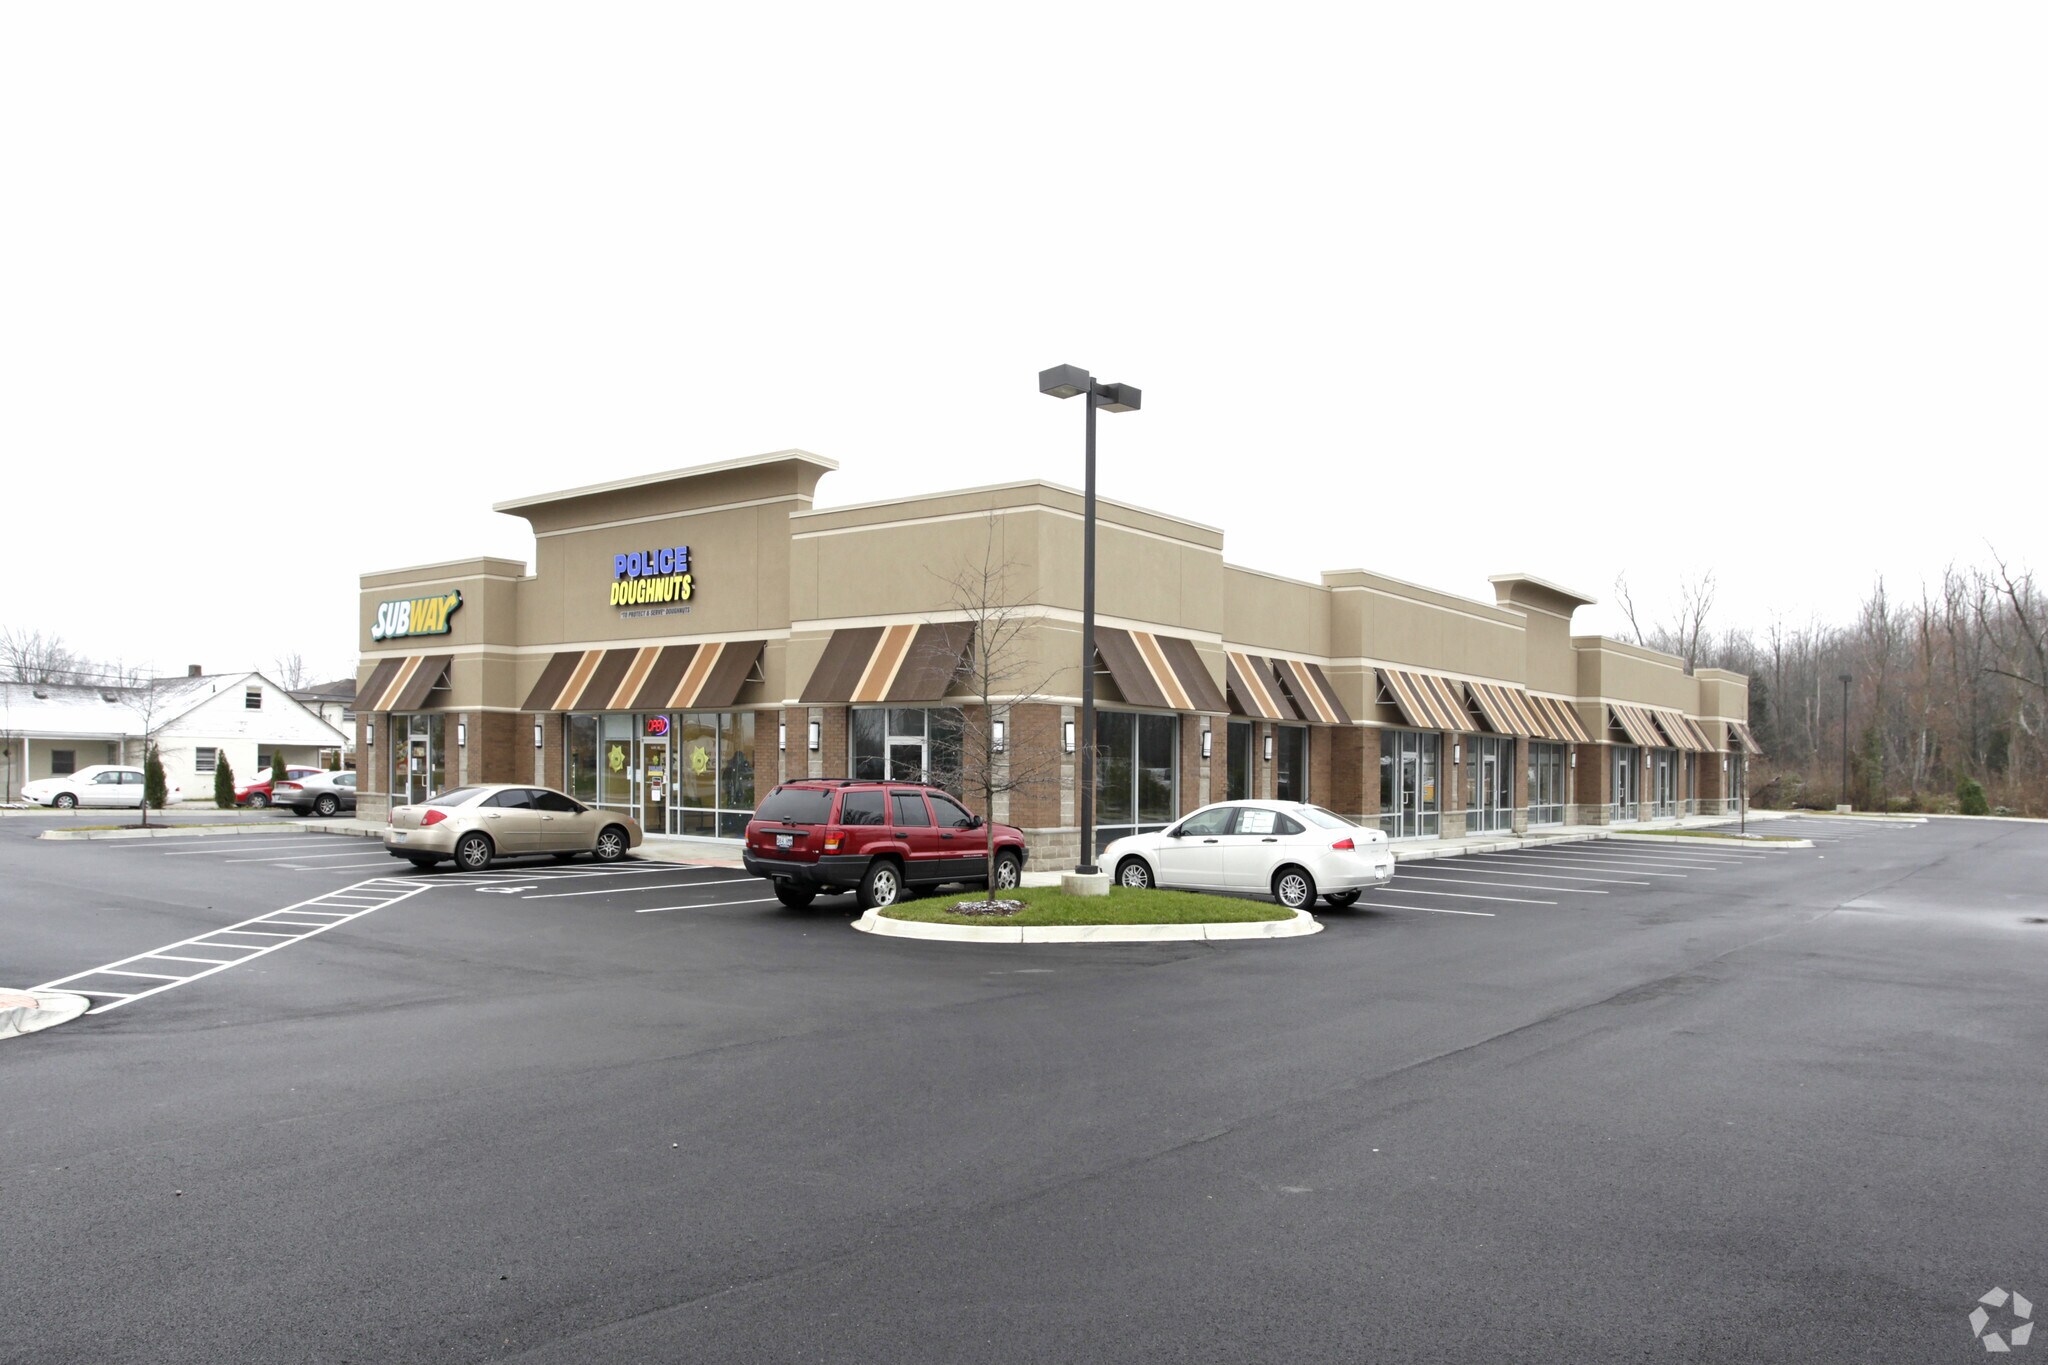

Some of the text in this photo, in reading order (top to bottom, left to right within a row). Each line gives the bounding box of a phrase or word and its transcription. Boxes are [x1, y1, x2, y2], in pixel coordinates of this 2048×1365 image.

[614, 546, 688, 579] POLICE
[610, 574, 692, 606] DOUGHNUTS
[371, 593, 457, 640] SUBWAY
[666, 606, 690, 615] DOUGHNUTS
[647, 719, 666, 732] OPEN
